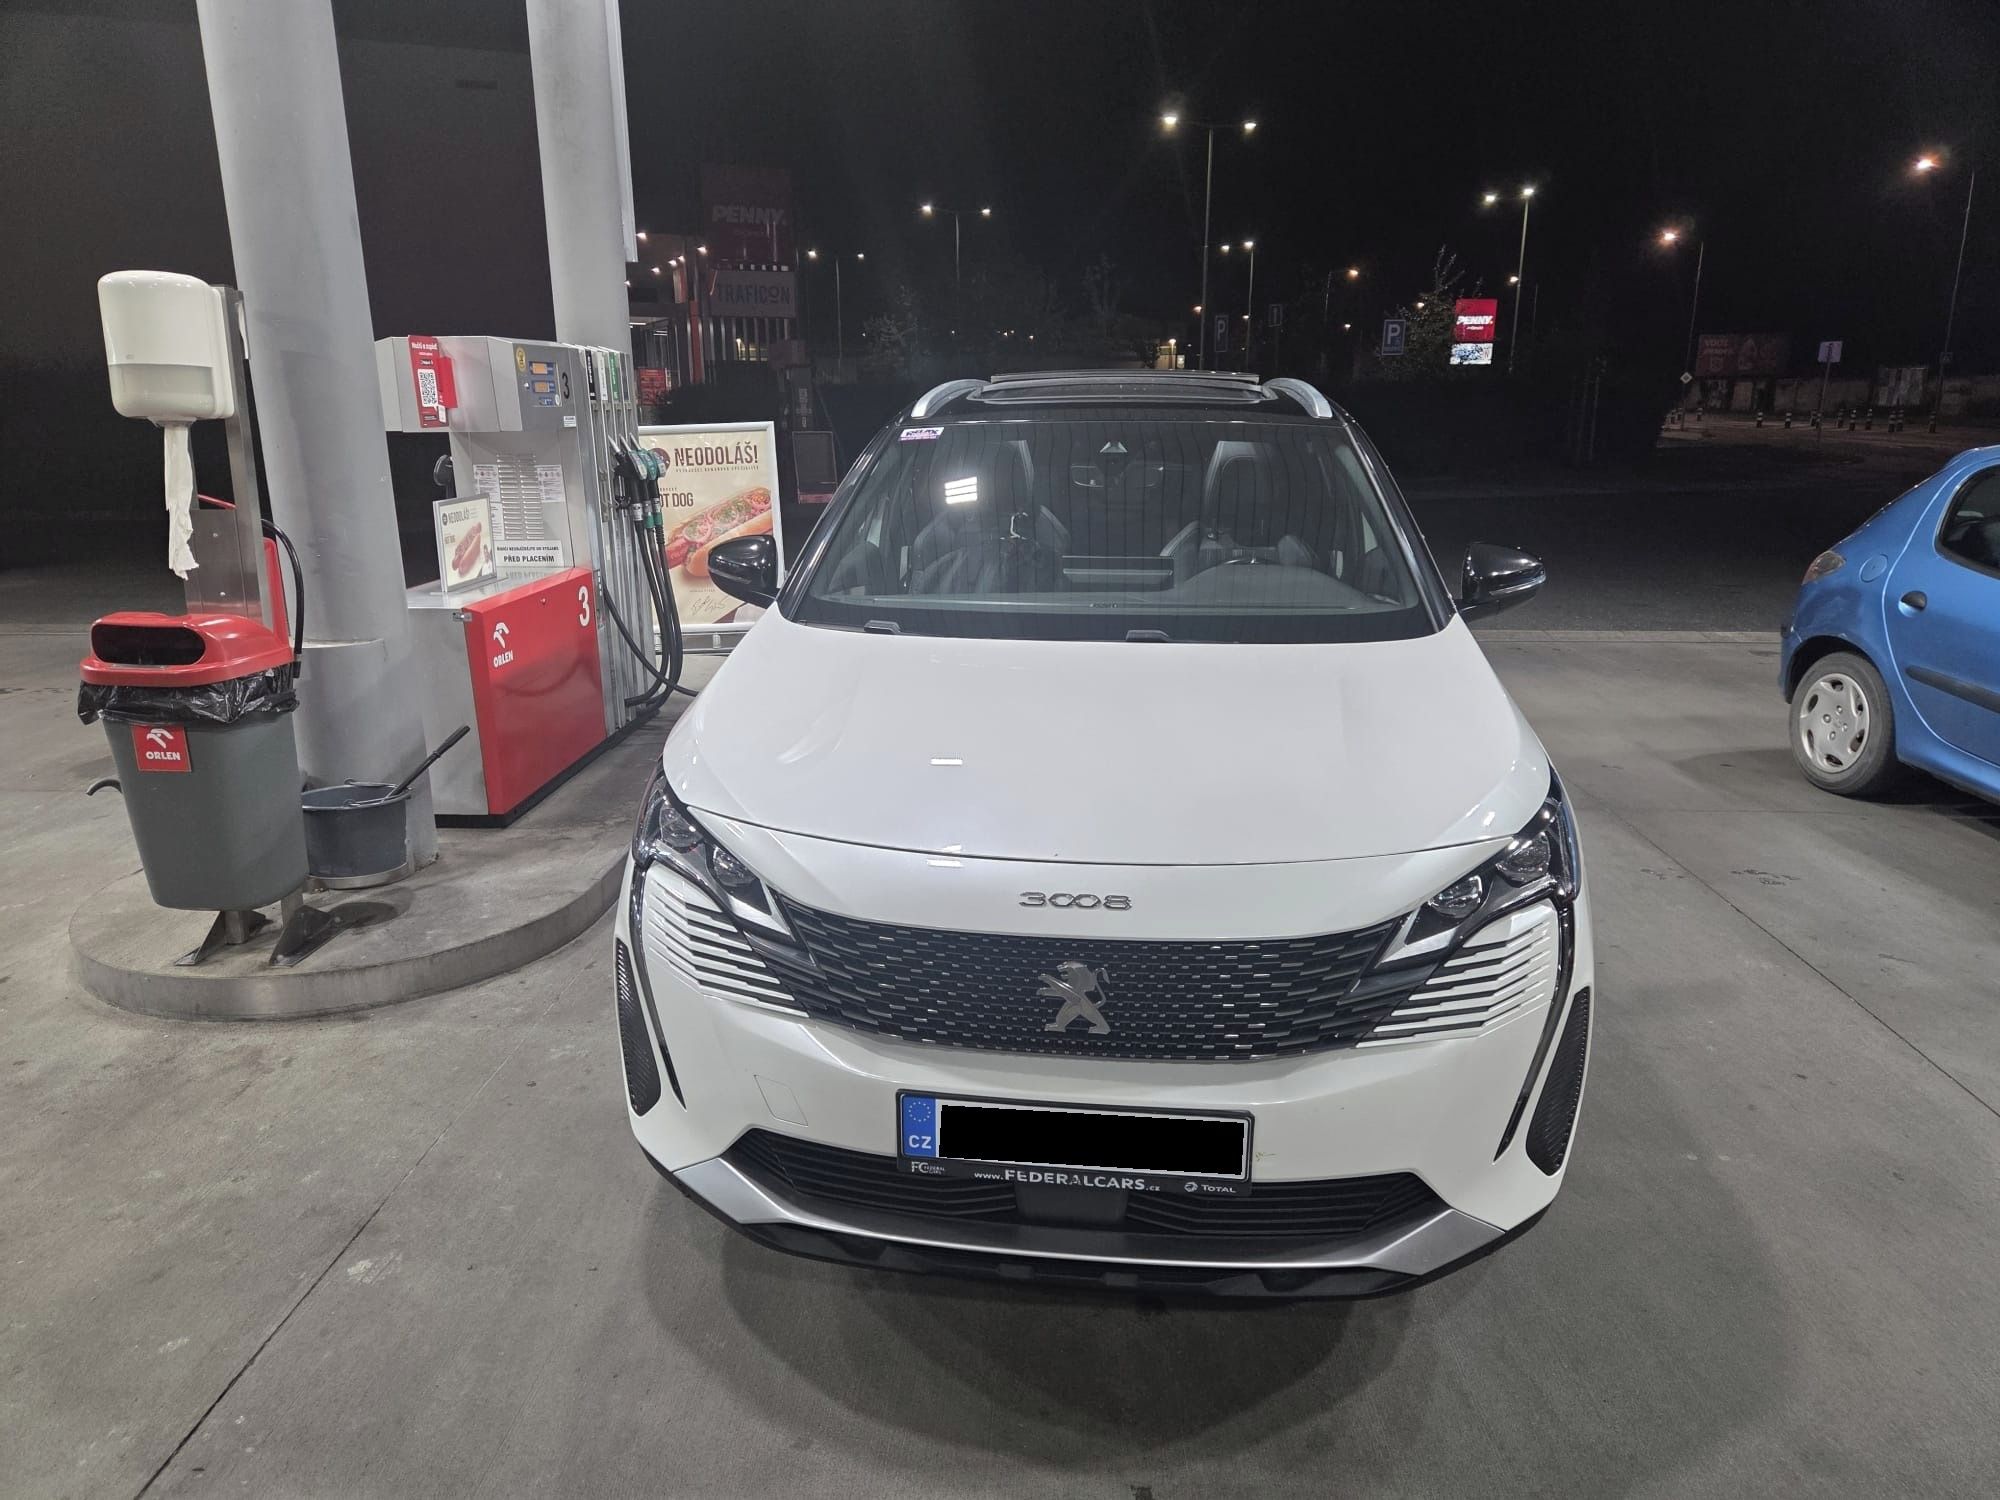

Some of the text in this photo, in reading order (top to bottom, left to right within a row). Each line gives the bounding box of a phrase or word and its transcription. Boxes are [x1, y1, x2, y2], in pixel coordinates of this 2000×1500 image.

[1388, 324, 1400, 345] P
[562, 372, 570, 399] 3
[674, 441, 758, 467] NEODOLÁŠ!
[659, 492, 693, 508] OT DOG
[503, 553, 555, 563] PŘED PLACENÍM
[578, 585, 590, 627] 3
[493, 650, 514, 668] ORLEN
[145, 751, 181, 761] ORLEN
[1018, 891, 1133, 911] 3008
[908, 1134, 932, 1149] CZ
[1201, 1184, 1237, 1193] TOTAL
